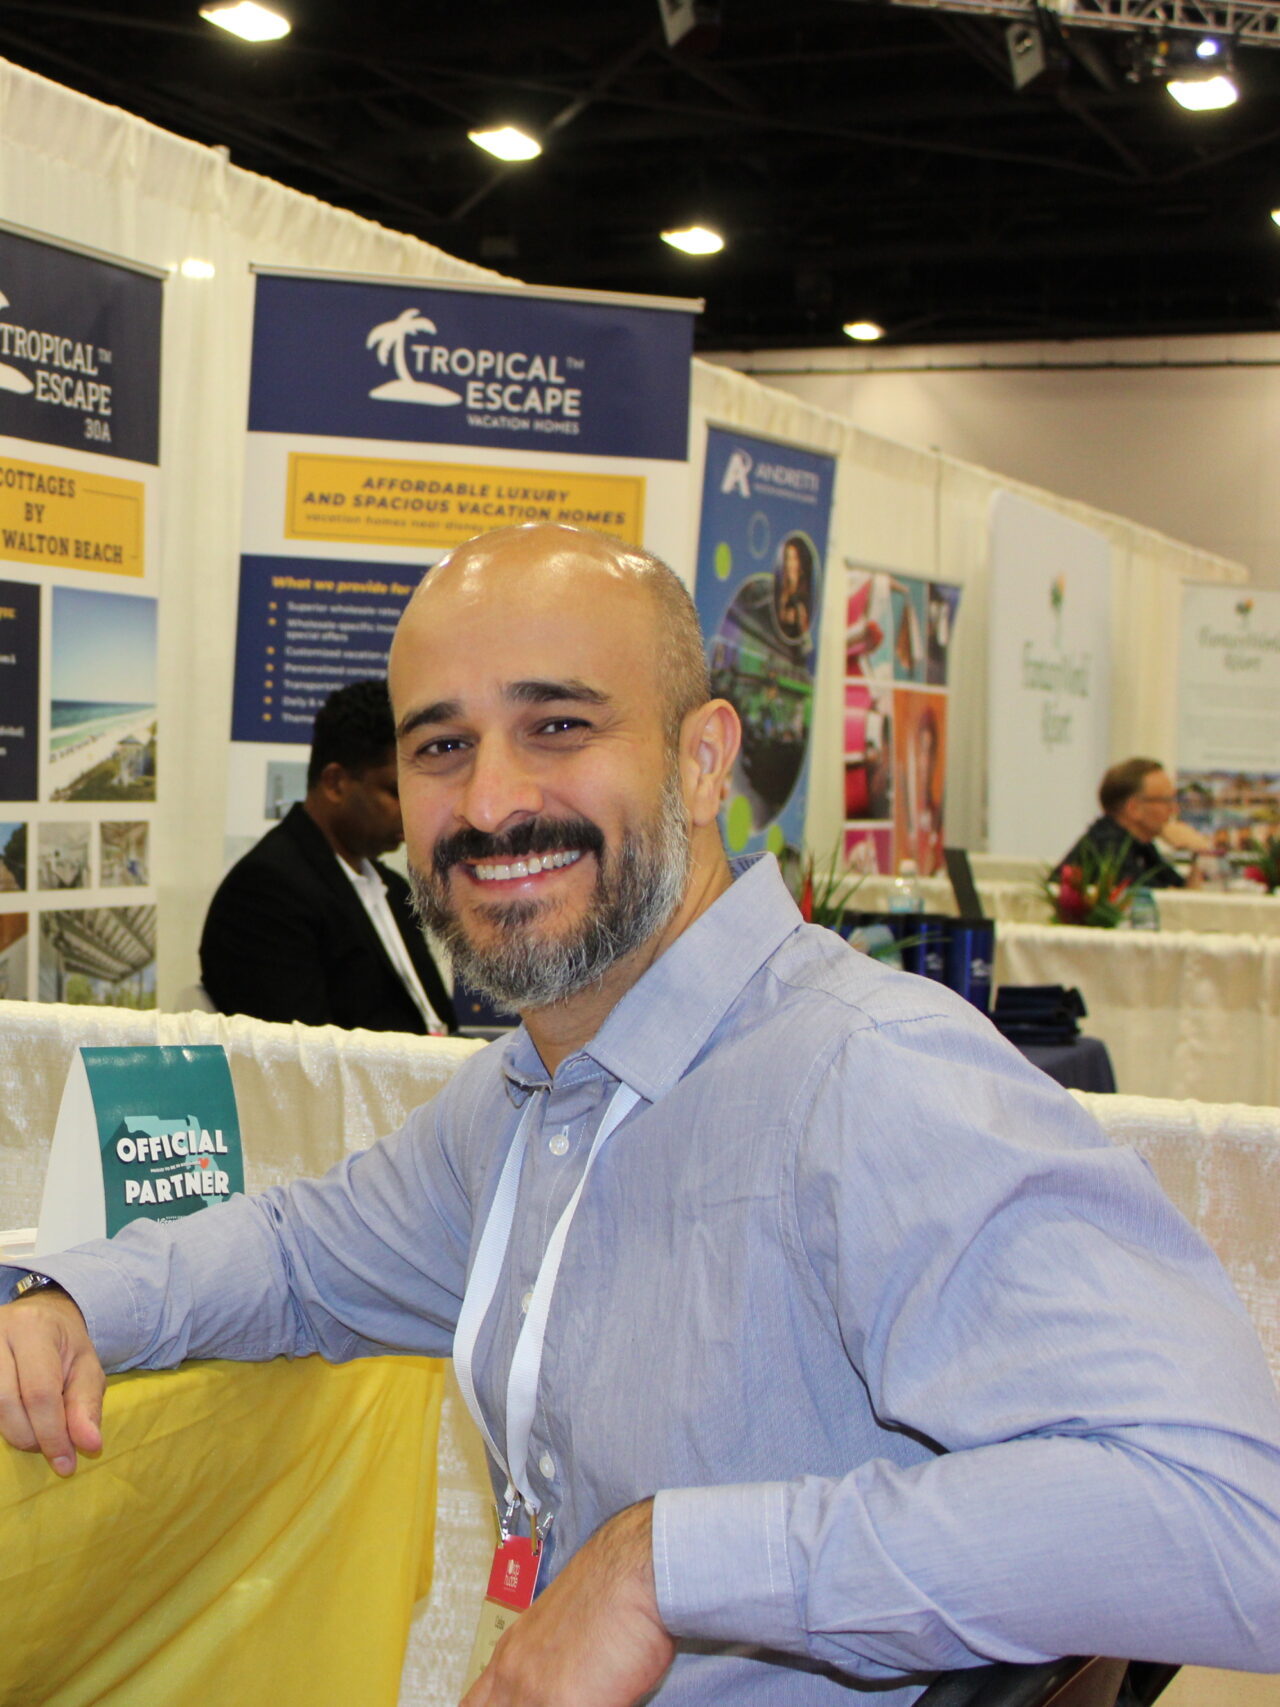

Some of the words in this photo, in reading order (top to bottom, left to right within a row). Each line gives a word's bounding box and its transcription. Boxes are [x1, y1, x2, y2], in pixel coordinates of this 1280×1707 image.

[410, 344, 566, 385] TROPICAL
[35, 369, 112, 416] ESCAPE
[466, 380, 583, 418] ESCAPE
[83, 417, 112, 443] 30A
[466, 413, 532, 431] VACATION
[533, 419, 581, 436] HOMES
[362, 476, 490, 498] AFFORDABLE
[496, 485, 569, 503] LUXURY
[24, 501, 46, 524] BY
[303, 491, 346, 507] AND
[352, 493, 450, 513] SPACIOUS
[458, 501, 552, 520] VACATION
[557, 508, 627, 525] HOMES
[1, 528, 70, 557] WALTON
[73, 539, 124, 565] BEACH
[271, 575, 312, 590] What
[314, 579, 335, 592] we
[336, 579, 388, 595] provide
[390, 582, 411, 596] for
[116, 1130, 228, 1163] OFFICIAL
[125, 1171, 229, 1204] PARTNER
